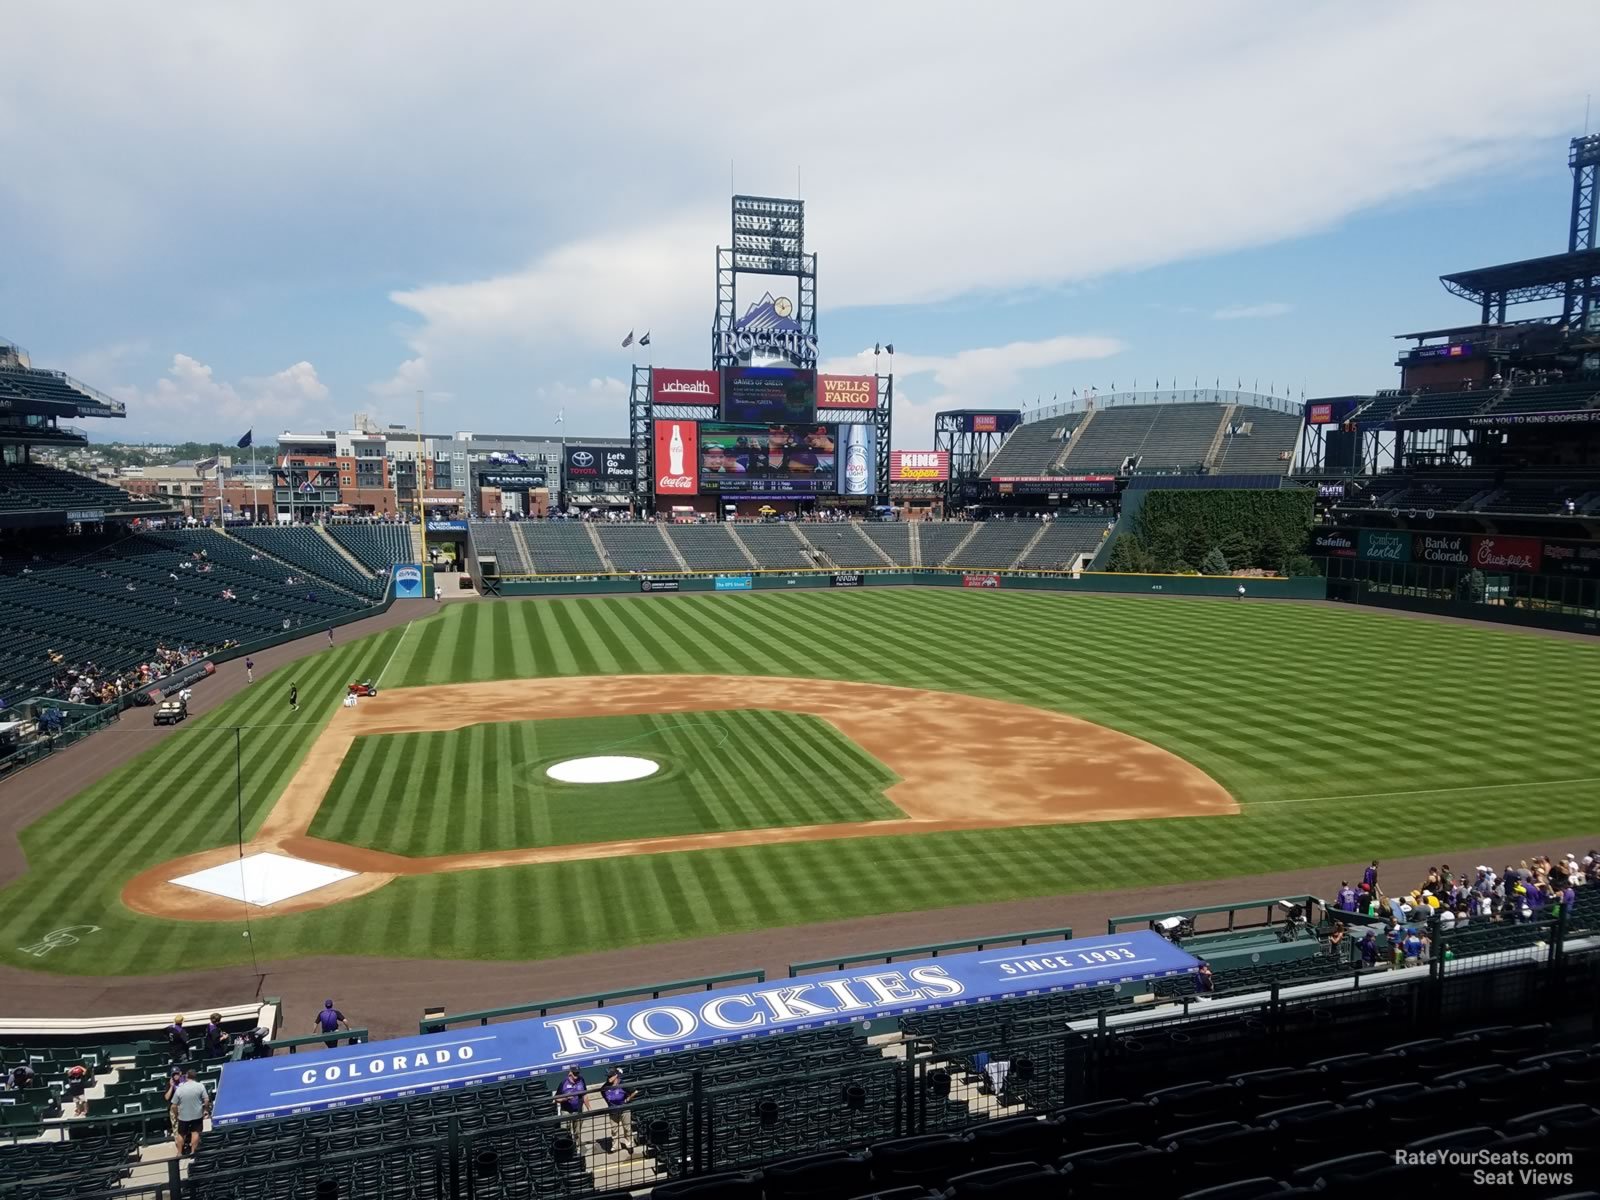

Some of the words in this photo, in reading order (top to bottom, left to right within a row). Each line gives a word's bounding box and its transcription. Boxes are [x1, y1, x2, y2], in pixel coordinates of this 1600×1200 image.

[718, 329, 820, 360] ROCKIES
[662, 379, 710, 394] uchealth
[824, 380, 870, 392] WELLS
[825, 392, 870, 403] FARGO
[1312, 406, 1329, 414] KING
[1548, 413, 1589, 422] SOOPERS
[901, 454, 939, 467] KING
[900, 466, 939, 480] Soopers
[1316, 537, 1351, 547] Safelite
[1369, 532, 1399, 546] Comfort
[1425, 537, 1449, 549] Bank
[1450, 538, 1461, 550] of
[1367, 544, 1402, 559] dental
[1424, 549, 1468, 563] Colorado
[1477, 544, 1532, 568] Chick-fil-A
[1000, 956, 1073, 975] SINCE
[1078, 948, 1136, 965] 1993
[543, 964, 966, 1060] ROCKIES
[302, 1045, 474, 1084] COLORADO
